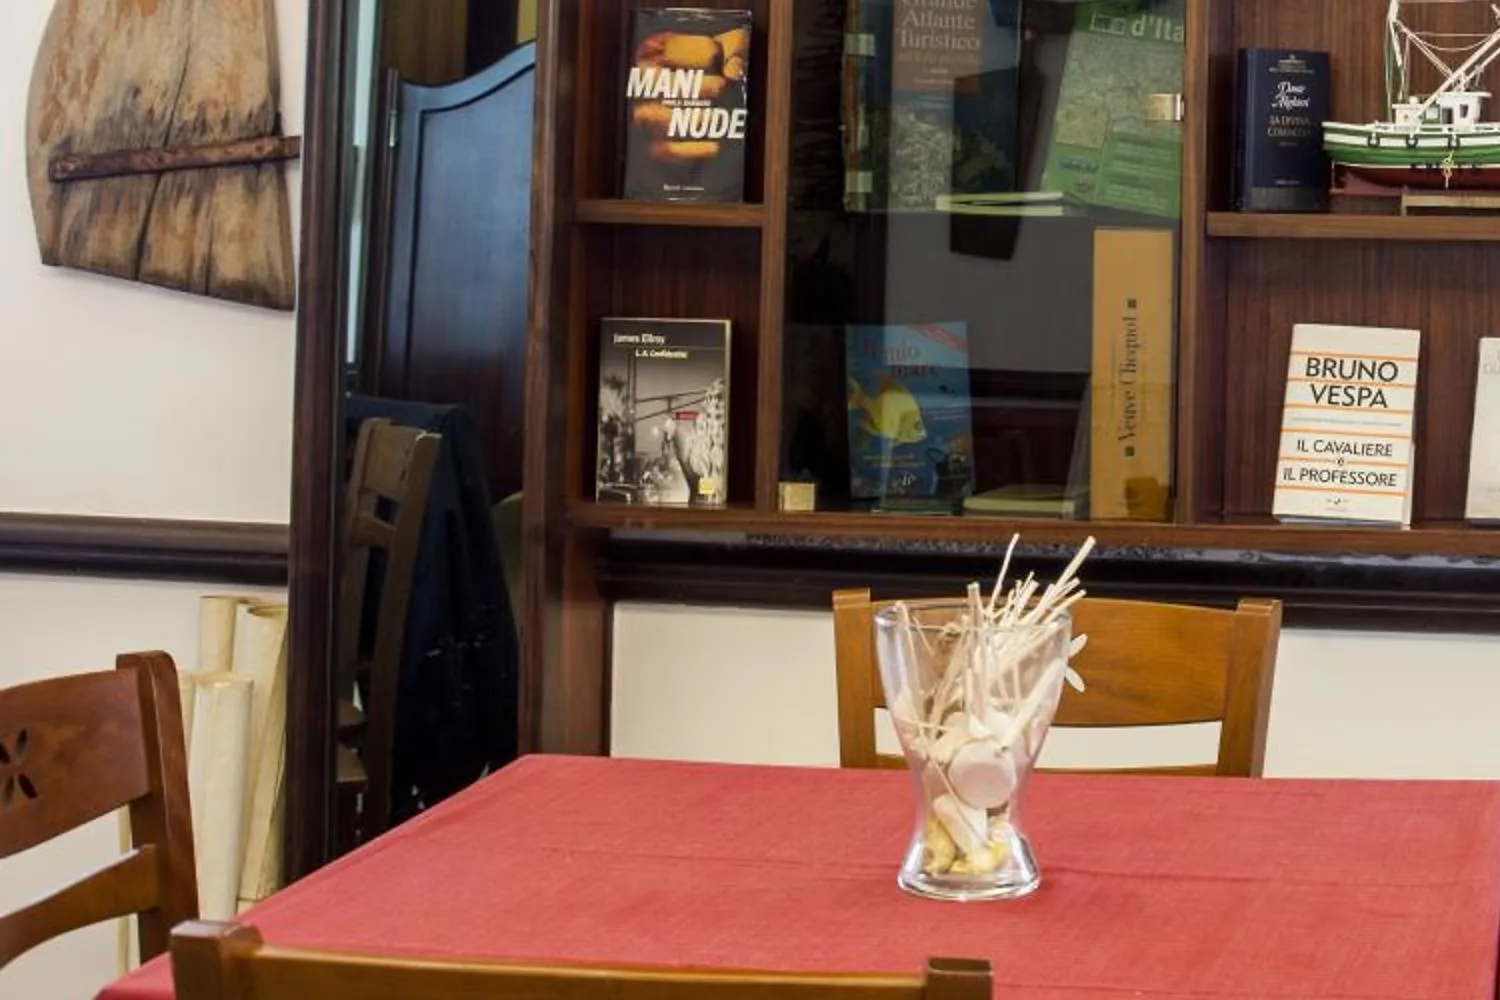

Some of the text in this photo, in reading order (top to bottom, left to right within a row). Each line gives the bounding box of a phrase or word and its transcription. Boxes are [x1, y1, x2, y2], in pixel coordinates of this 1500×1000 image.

[901, 9, 977, 31] Atlante
[898, 28, 980, 51] Turistico
[626, 67, 704, 99] MANI
[667, 107, 748, 139] NUDE
[1117, 315, 1145, 441] Veuve Clicquot
[1305, 357, 1399, 383] BRUNO
[1311, 384, 1388, 409] VESPA
[1296, 439, 1393, 457] IL CAVALIERE
[1283, 467, 1397, 487] IL PROFESSORE
